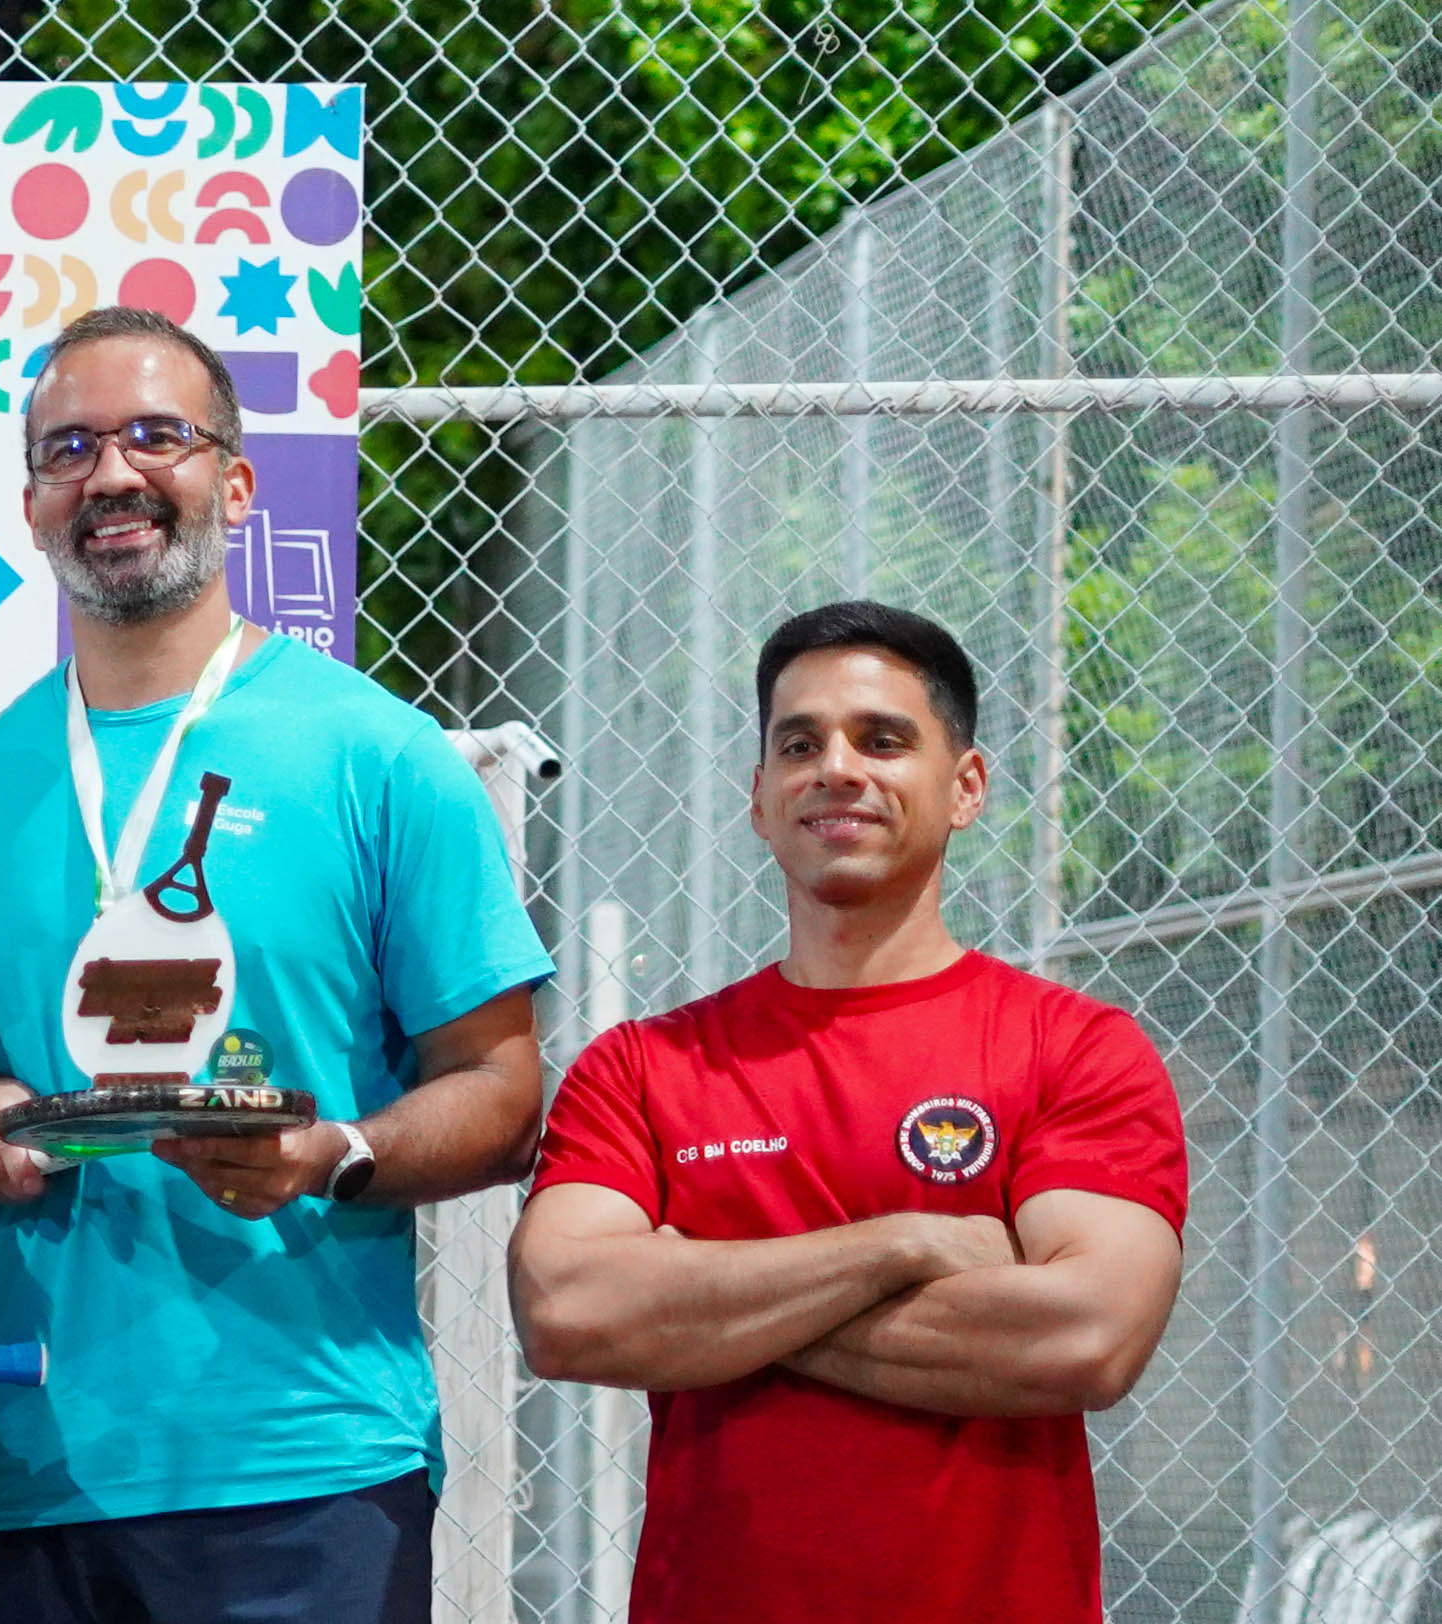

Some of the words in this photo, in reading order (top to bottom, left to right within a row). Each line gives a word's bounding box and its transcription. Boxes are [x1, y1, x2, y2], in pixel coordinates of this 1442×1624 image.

[902, 1098, 955, 1129] BOMBEIROS
[676, 1146, 698, 1163] CB
[704, 1142, 725, 1158] BM
[730, 1136, 788, 1153] COELHO
[931, 1169, 957, 1182] 1975
